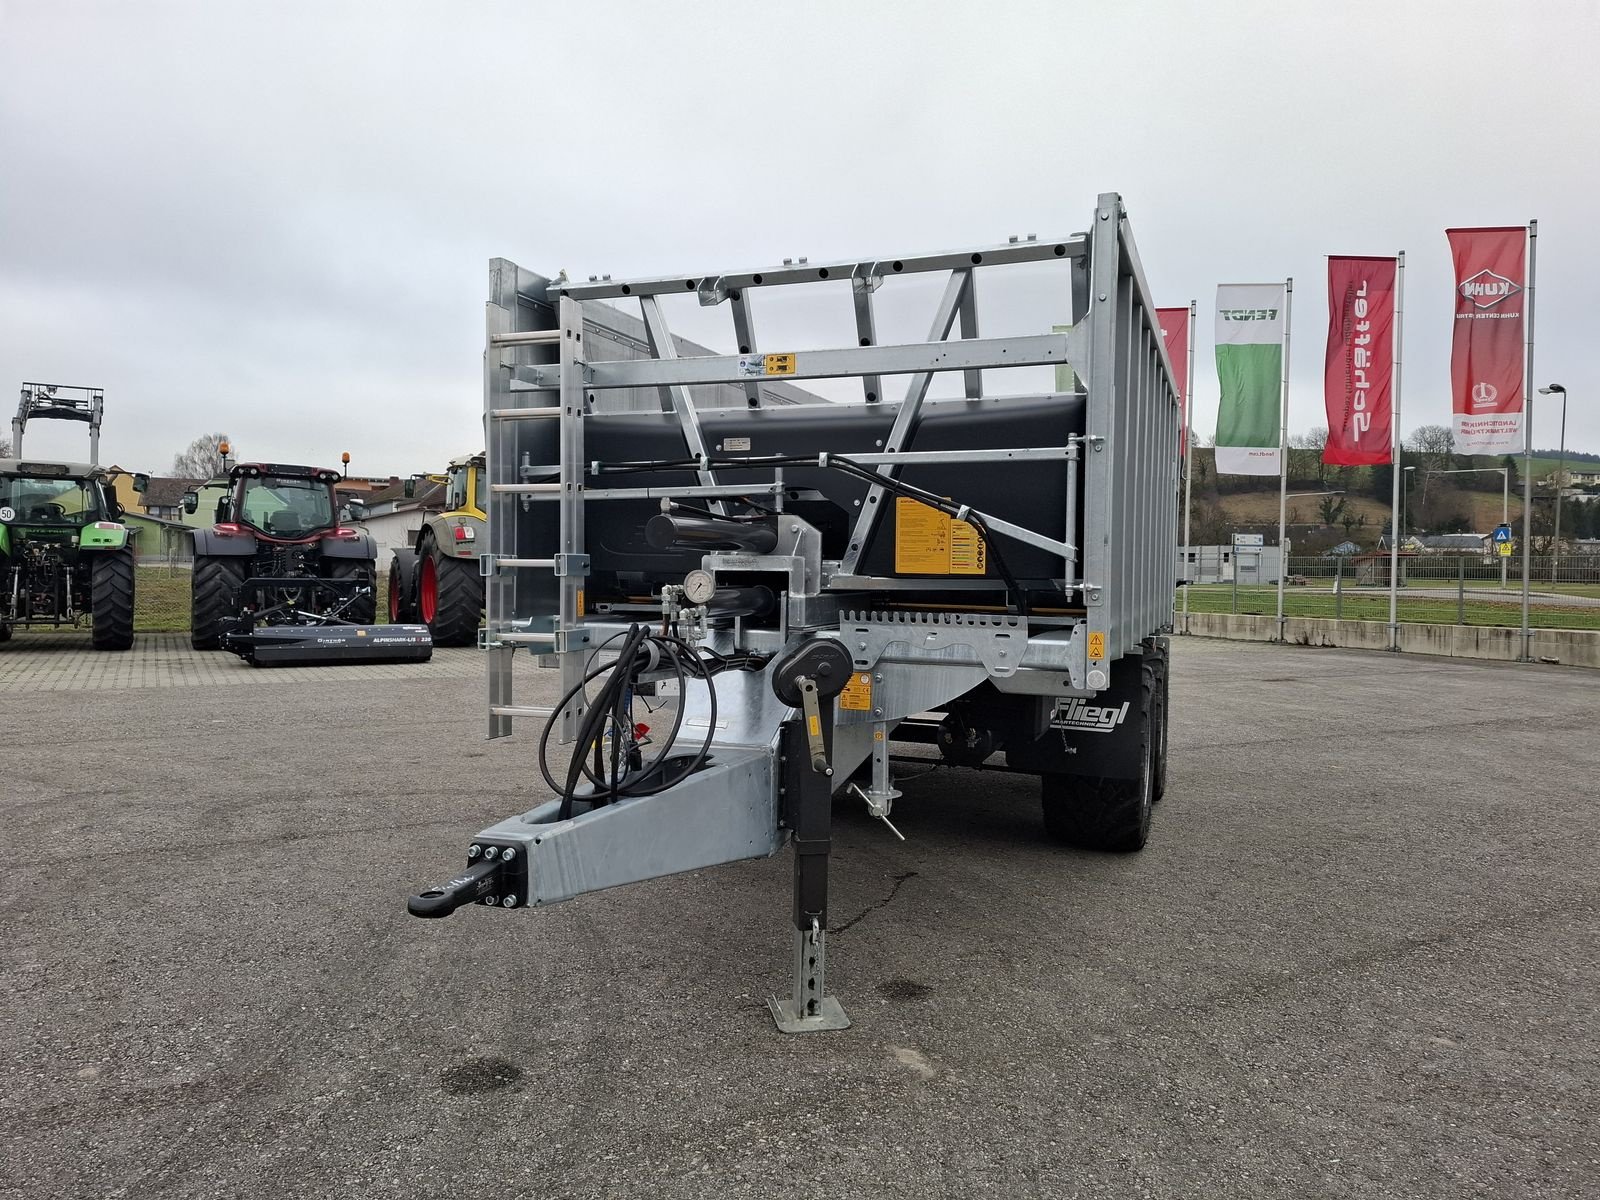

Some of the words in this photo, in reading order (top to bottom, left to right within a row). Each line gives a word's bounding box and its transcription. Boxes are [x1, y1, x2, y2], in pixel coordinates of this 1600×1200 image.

[1, 509, 12, 519] 50
[1052, 697, 1130, 728] Fliegl
[1052, 719, 1097, 727] RARTECHNIK
